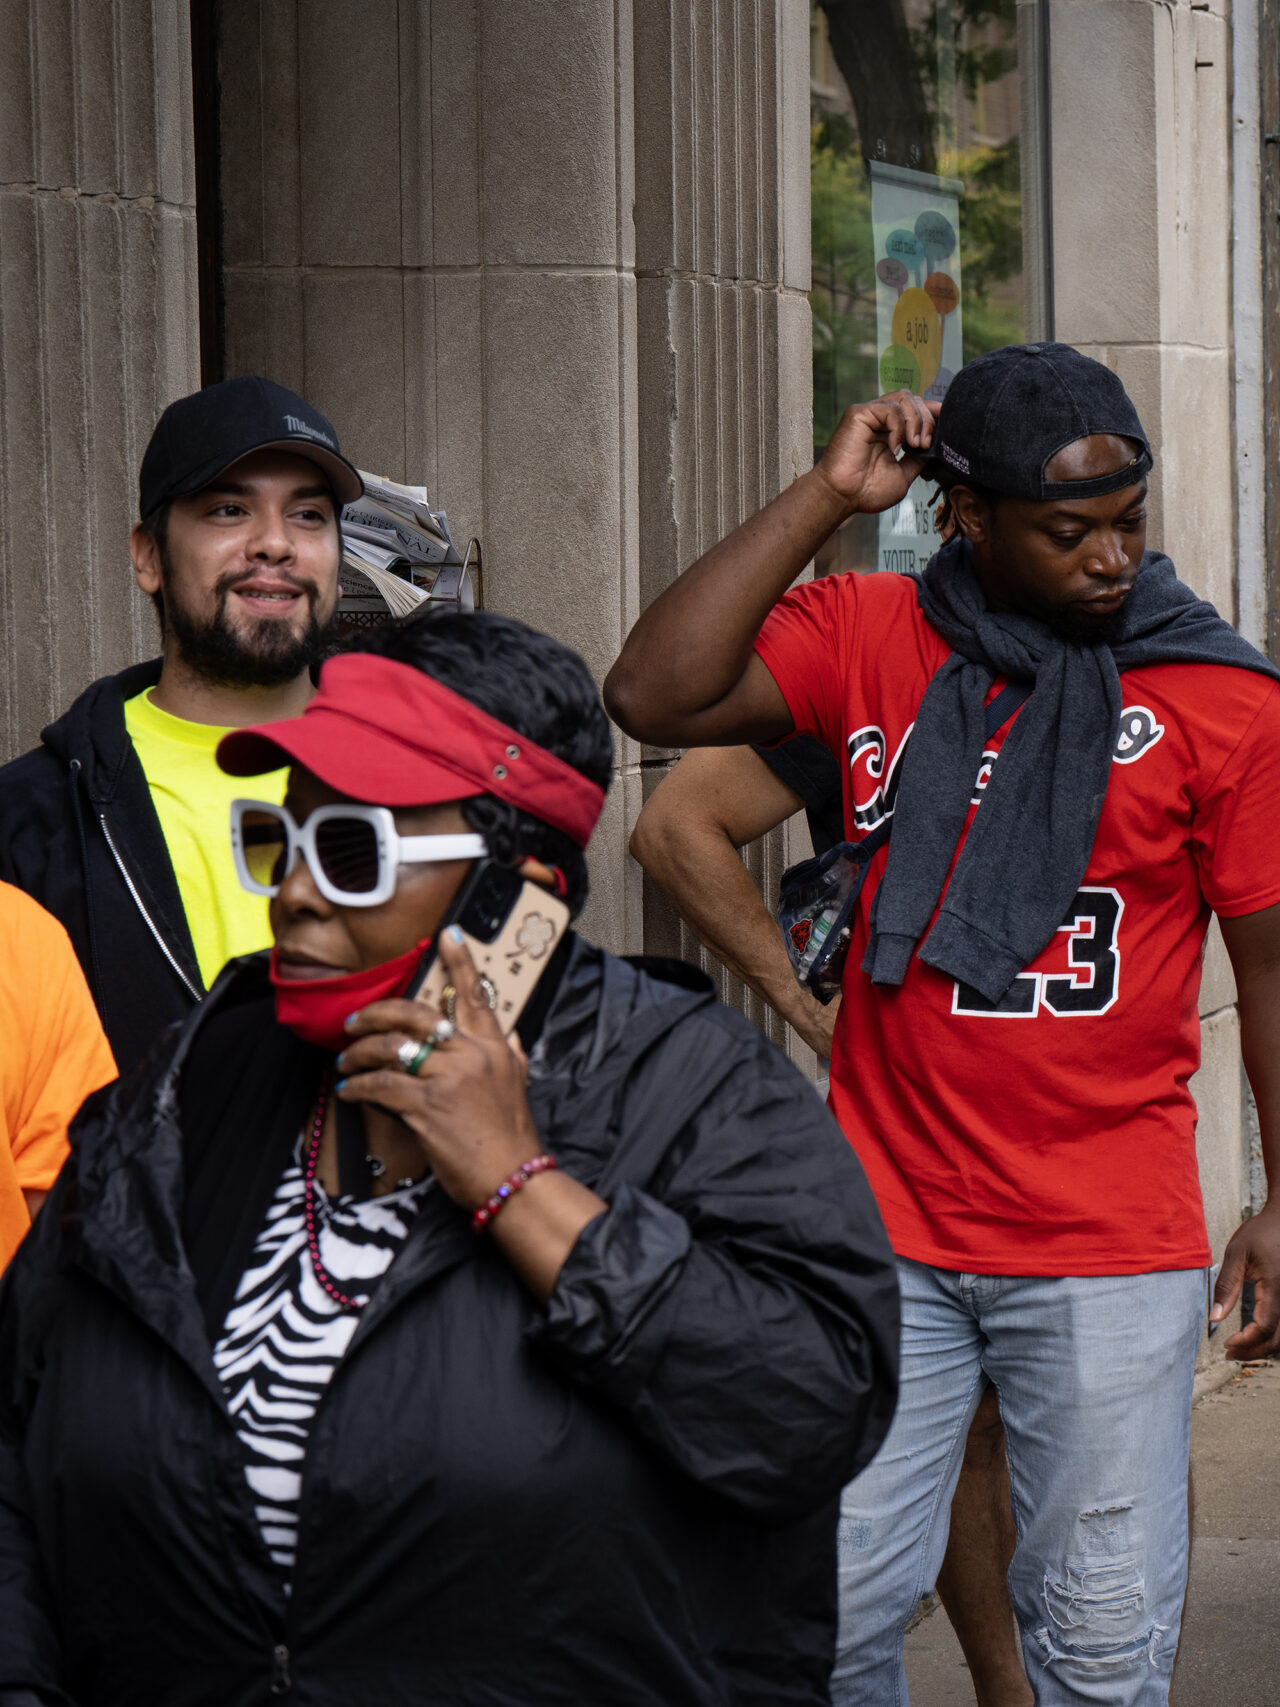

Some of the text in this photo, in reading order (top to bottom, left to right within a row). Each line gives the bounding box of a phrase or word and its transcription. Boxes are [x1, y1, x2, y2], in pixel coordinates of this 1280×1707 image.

[906, 316, 929, 350] a job
[951, 886, 1125, 1018] 3
